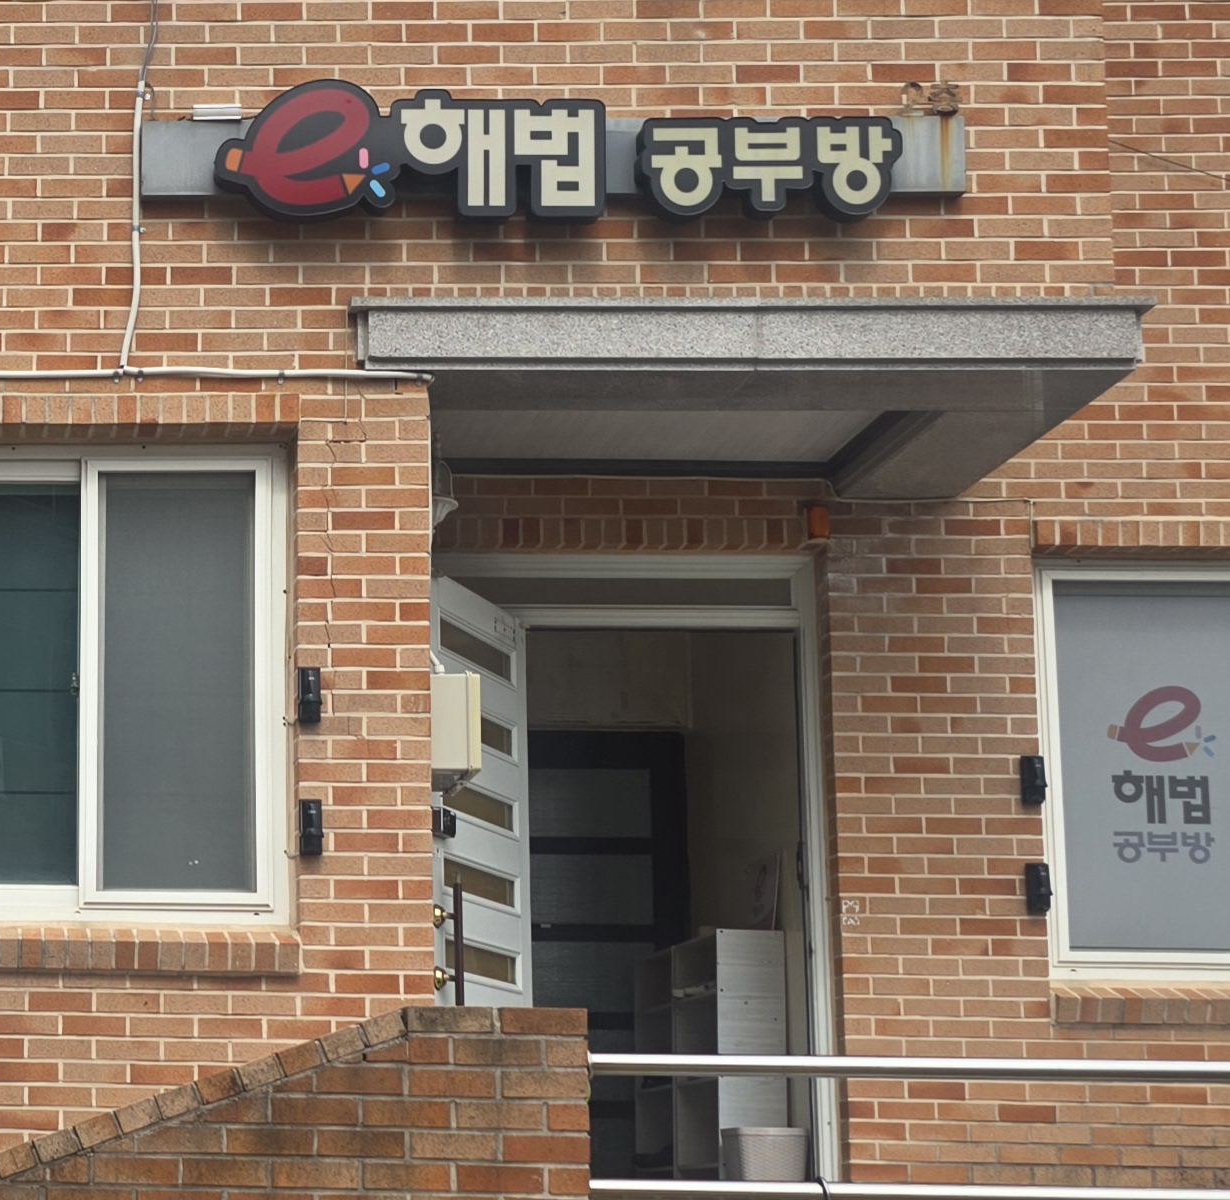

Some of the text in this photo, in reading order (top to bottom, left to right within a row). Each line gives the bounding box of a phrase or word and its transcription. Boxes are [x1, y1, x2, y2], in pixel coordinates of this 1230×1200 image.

[401, 98, 595, 207] 해법
[652, 126, 892, 206] 공부방
[1111, 770, 1211, 824] 해법
[1113, 831, 1215, 864] 공부방
